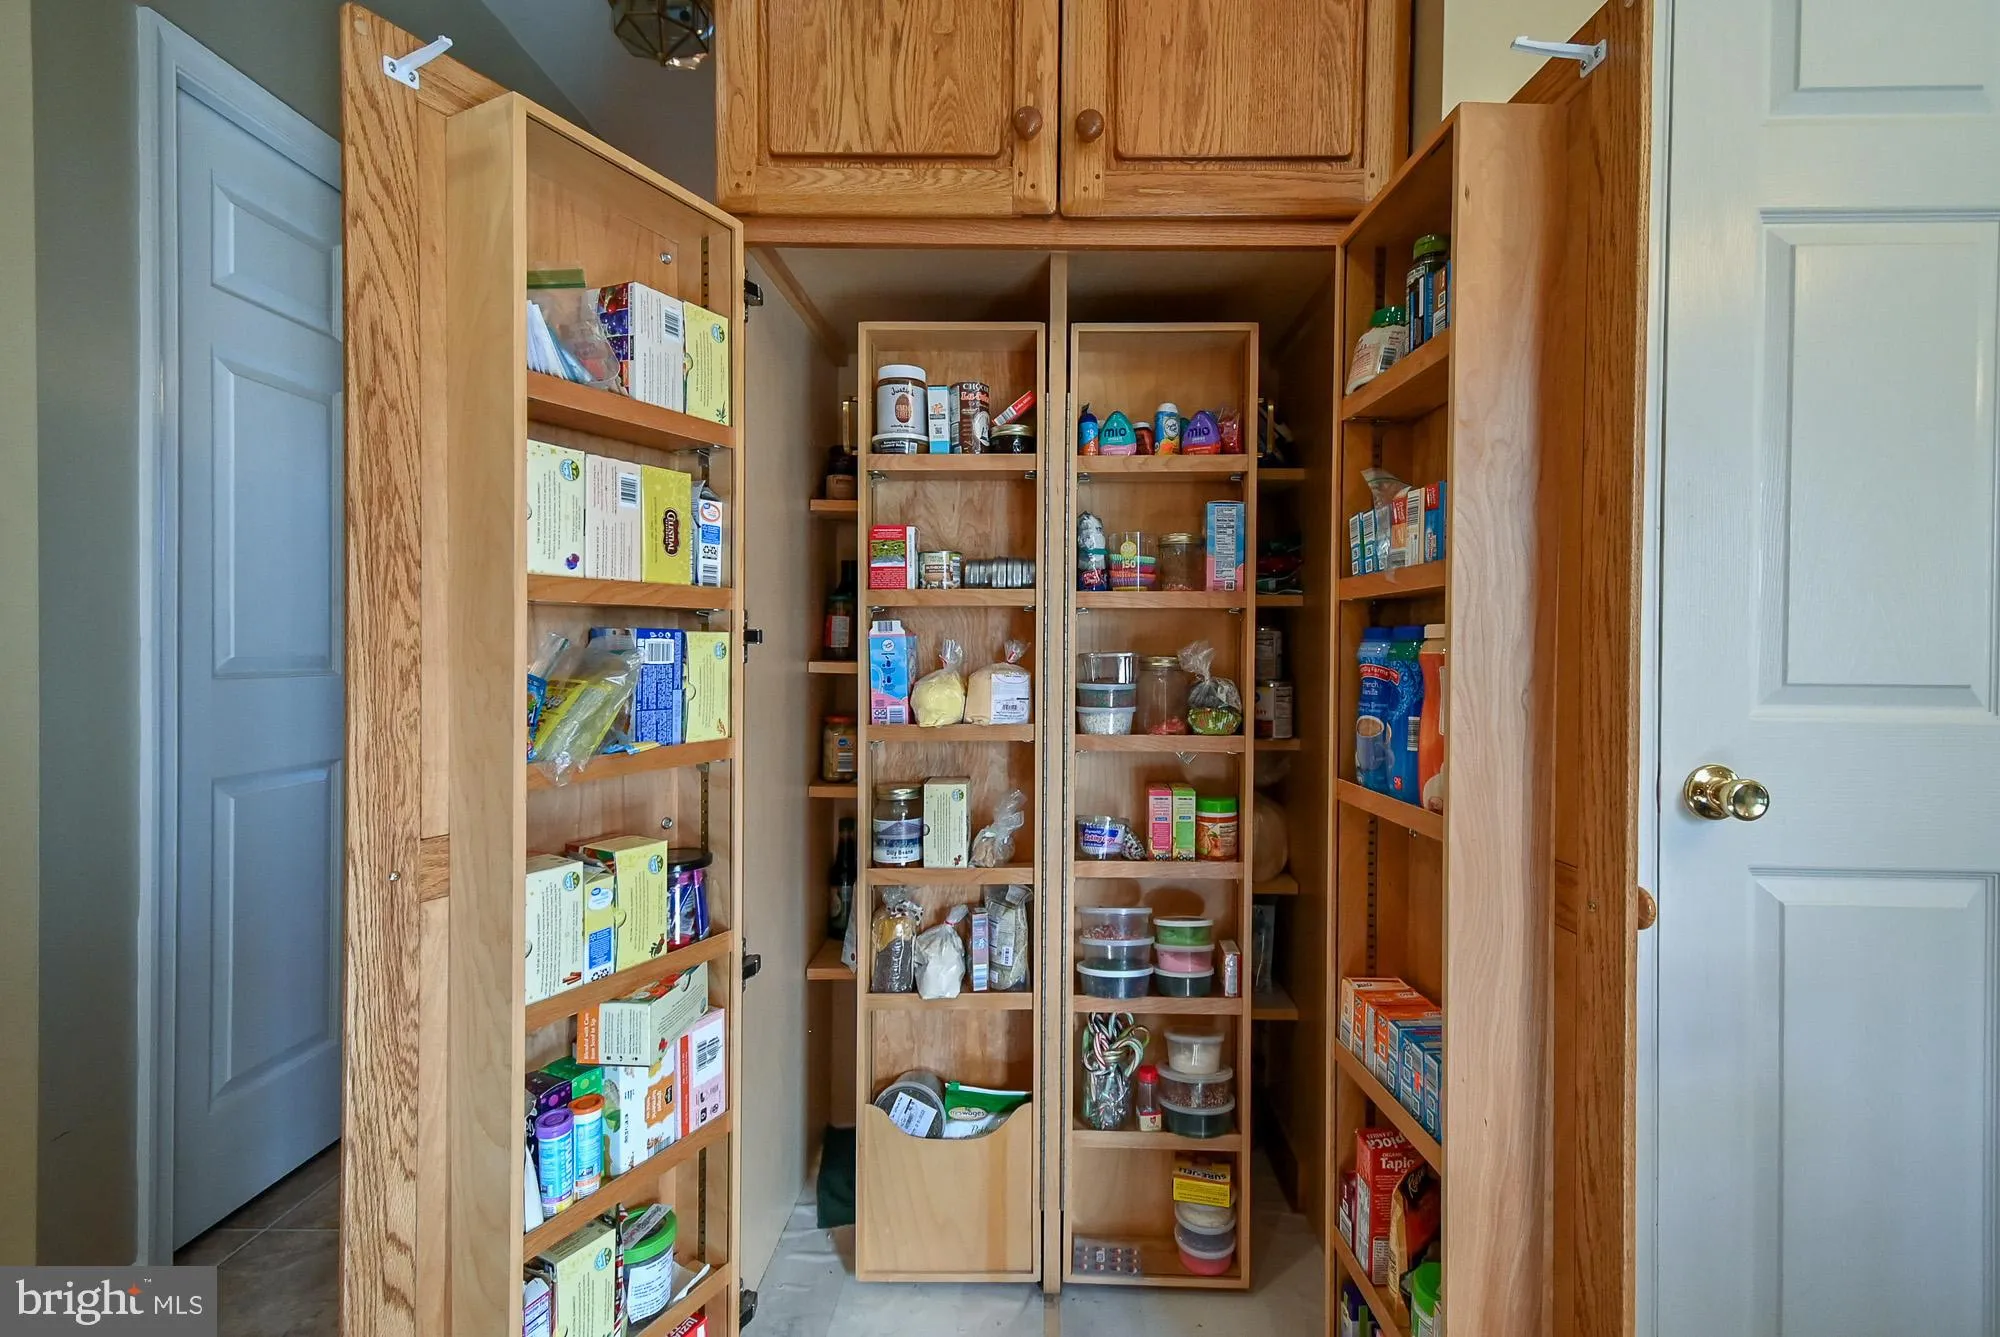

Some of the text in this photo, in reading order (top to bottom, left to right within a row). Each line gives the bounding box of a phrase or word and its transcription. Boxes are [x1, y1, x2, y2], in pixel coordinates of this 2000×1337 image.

[1104, 427, 1127, 437] mio
[1187, 427, 1210, 437] mio
[666, 511, 676, 552] CELESTIAL
[1122, 560, 1136, 569] 150
[1366, 1132, 1406, 1150] pioca
[1380, 1156, 1415, 1172] Tapio
